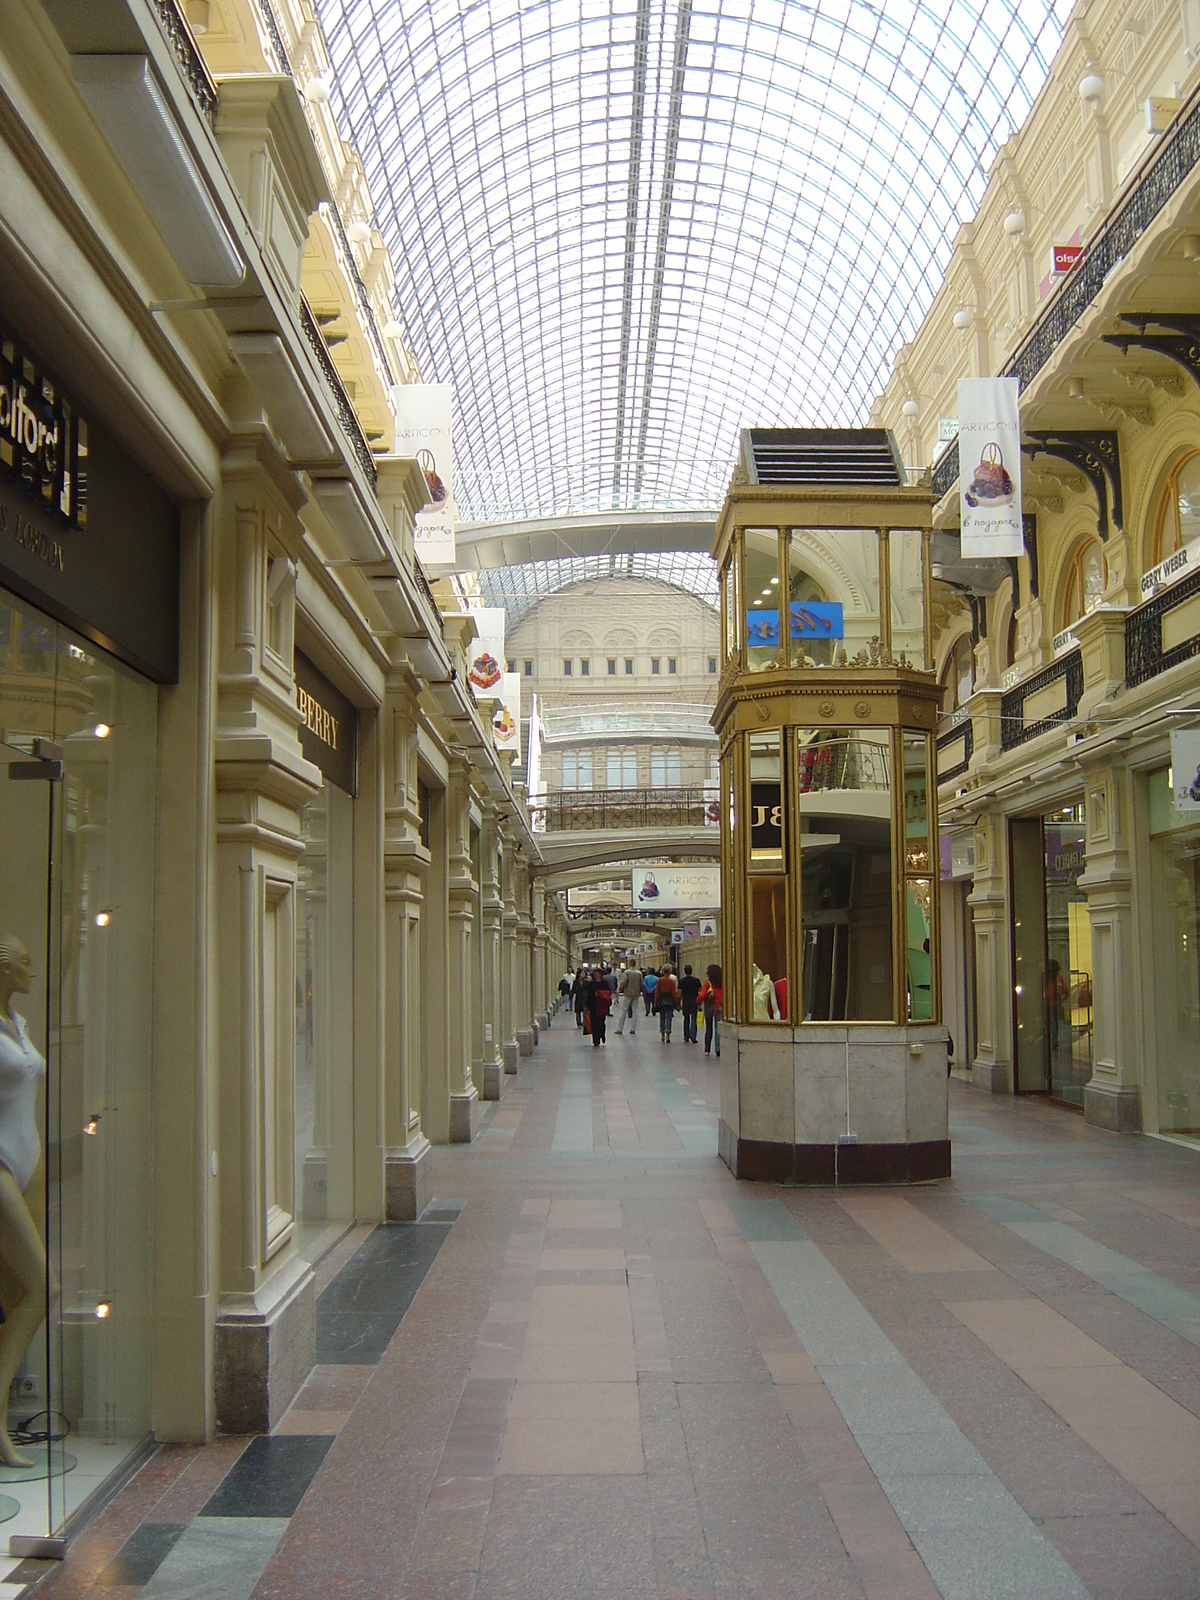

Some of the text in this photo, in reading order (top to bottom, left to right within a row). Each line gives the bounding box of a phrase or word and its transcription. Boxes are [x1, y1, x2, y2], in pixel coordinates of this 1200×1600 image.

[961, 421, 1017, 432] ARTICOLI
[397, 428, 451, 438] ARTICOLI
[1141, 549, 1188, 592] GERRY WEBER
[298, 687, 339, 750] BERRY
[667, 875, 717, 885] ARTICOLI
